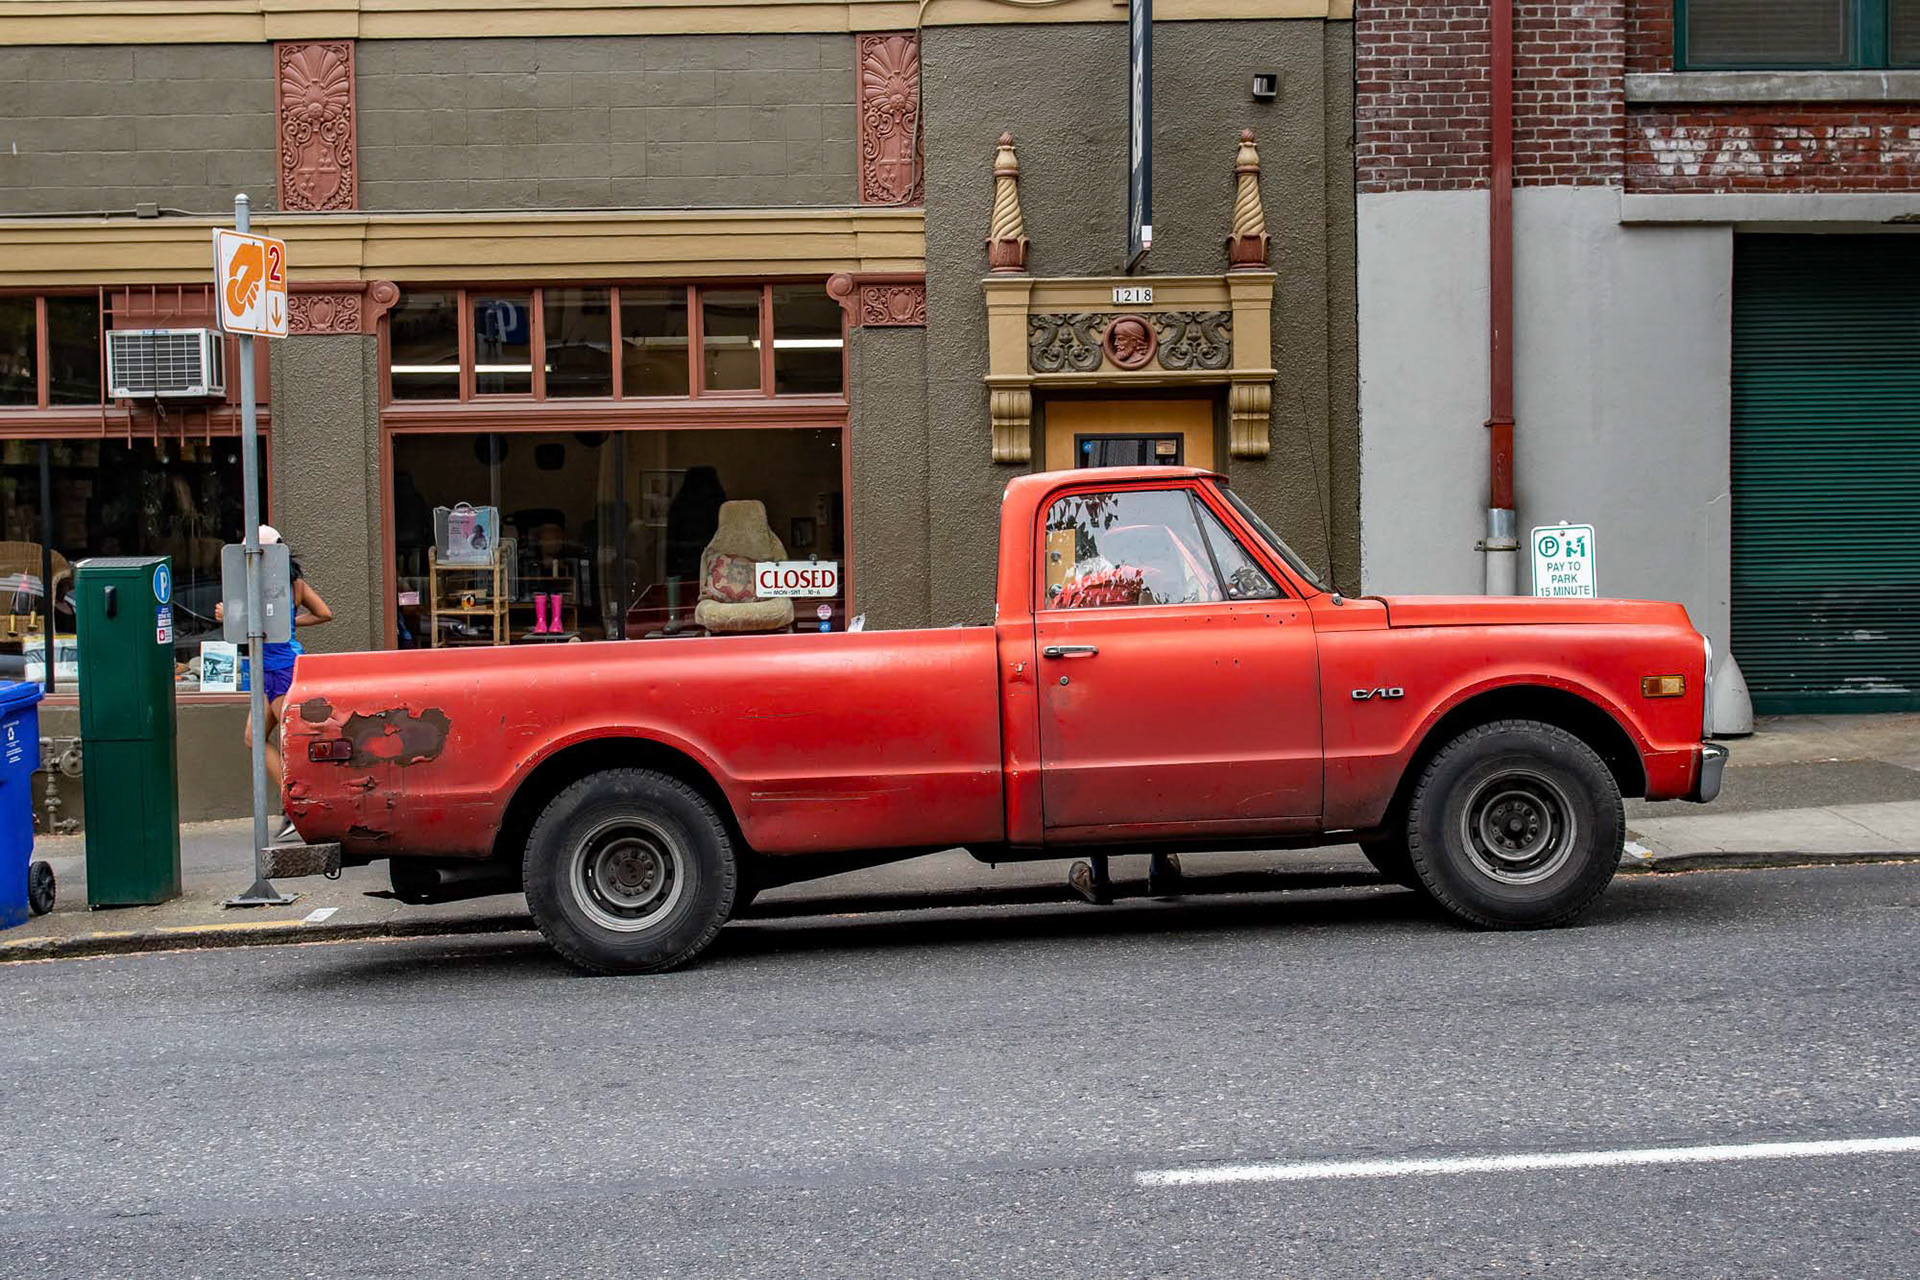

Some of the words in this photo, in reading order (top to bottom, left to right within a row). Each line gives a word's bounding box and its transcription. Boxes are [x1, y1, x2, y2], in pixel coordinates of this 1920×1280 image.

[268, 245, 281, 283] 2
[1115, 289, 1152, 302] 1218
[1546, 562, 1565, 572] PAY
[1568, 561, 1581, 571] TO
[760, 569, 835, 589] CLOSED
[1551, 574, 1578, 584] PARK
[1540, 587, 1550, 597] 15
[1553, 585, 1590, 597] MINUTE
[1351, 687, 1404, 700] C/10
